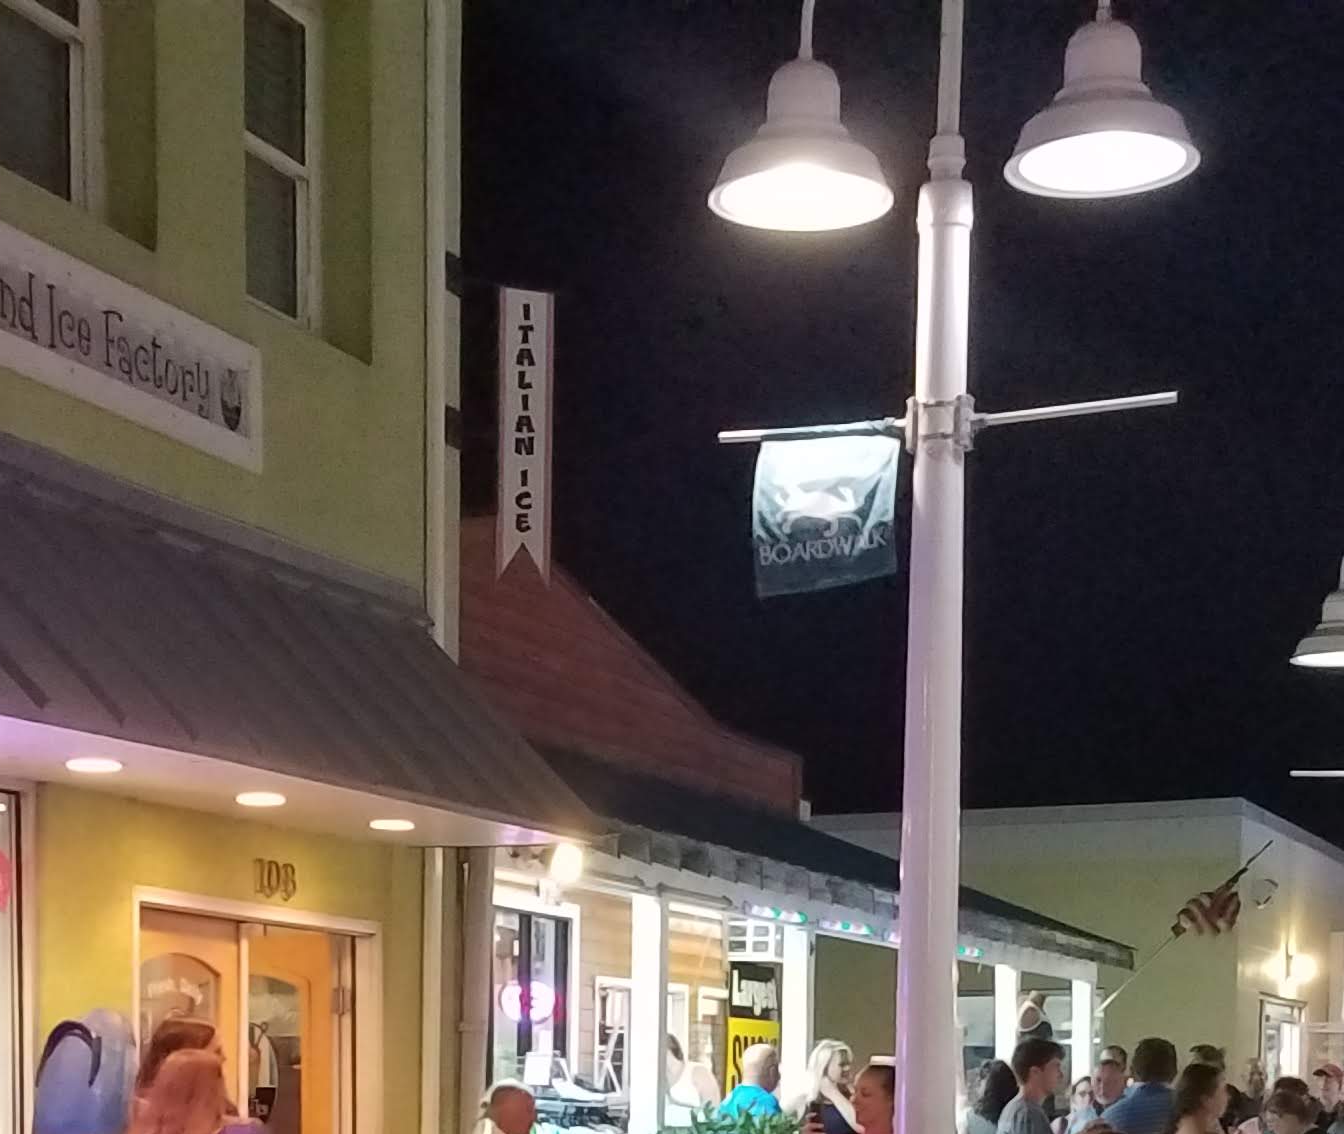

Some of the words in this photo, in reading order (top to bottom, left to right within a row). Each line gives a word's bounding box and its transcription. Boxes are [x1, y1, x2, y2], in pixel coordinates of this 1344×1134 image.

[46, 283, 93, 357] Ice
[102, 309, 211, 419] Factory
[513, 302, 537, 457] ITALIAN
[514, 468, 534, 534] ICE
[759, 525, 887, 567] BOARDWALK
